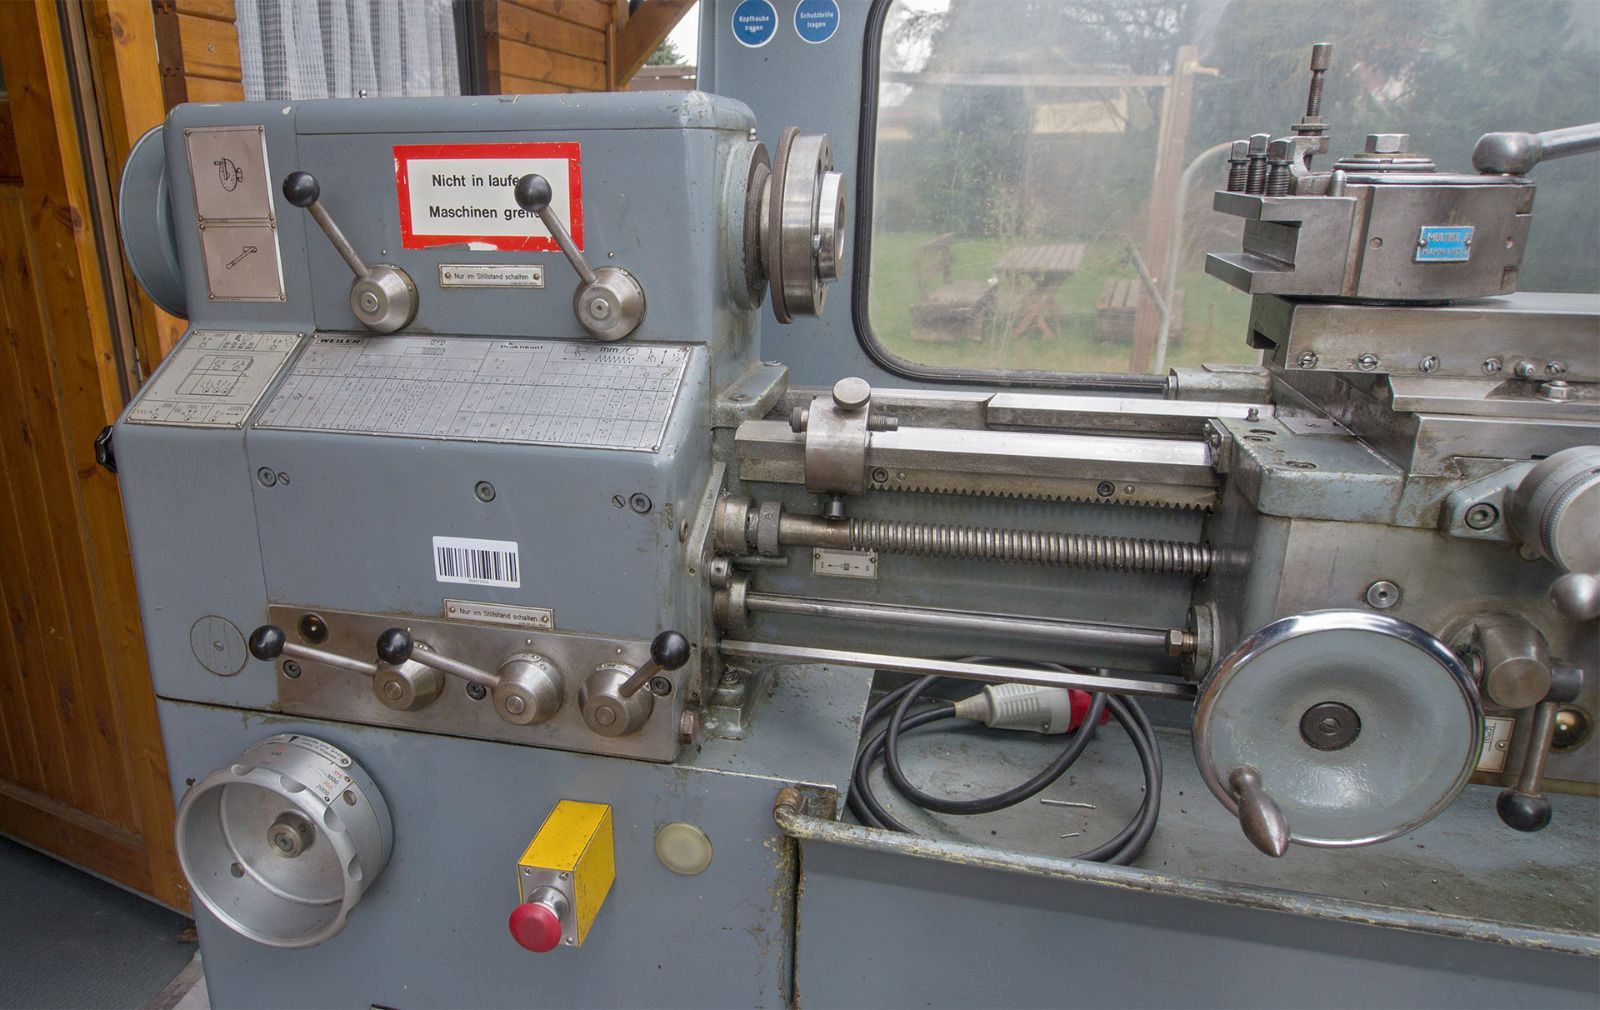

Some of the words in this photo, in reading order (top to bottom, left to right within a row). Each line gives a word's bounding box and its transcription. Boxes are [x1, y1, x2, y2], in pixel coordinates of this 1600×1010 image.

[739, 15, 769, 23] Kopfhaube
[800, 11, 834, 19] Schutzbrille
[807, 21, 826, 29] tragen
[432, 174, 466, 187] Nicht
[472, 174, 484, 187] in
[429, 205, 498, 218] Maschinen
[454, 272, 465, 280] Nur
[476, 273, 503, 281] Stillstand
[504, 273, 529, 281] schalten
[459, 607, 470, 615] Nur
[483, 610, 511, 618] Stillstand
[512, 613, 538, 622] schalten
